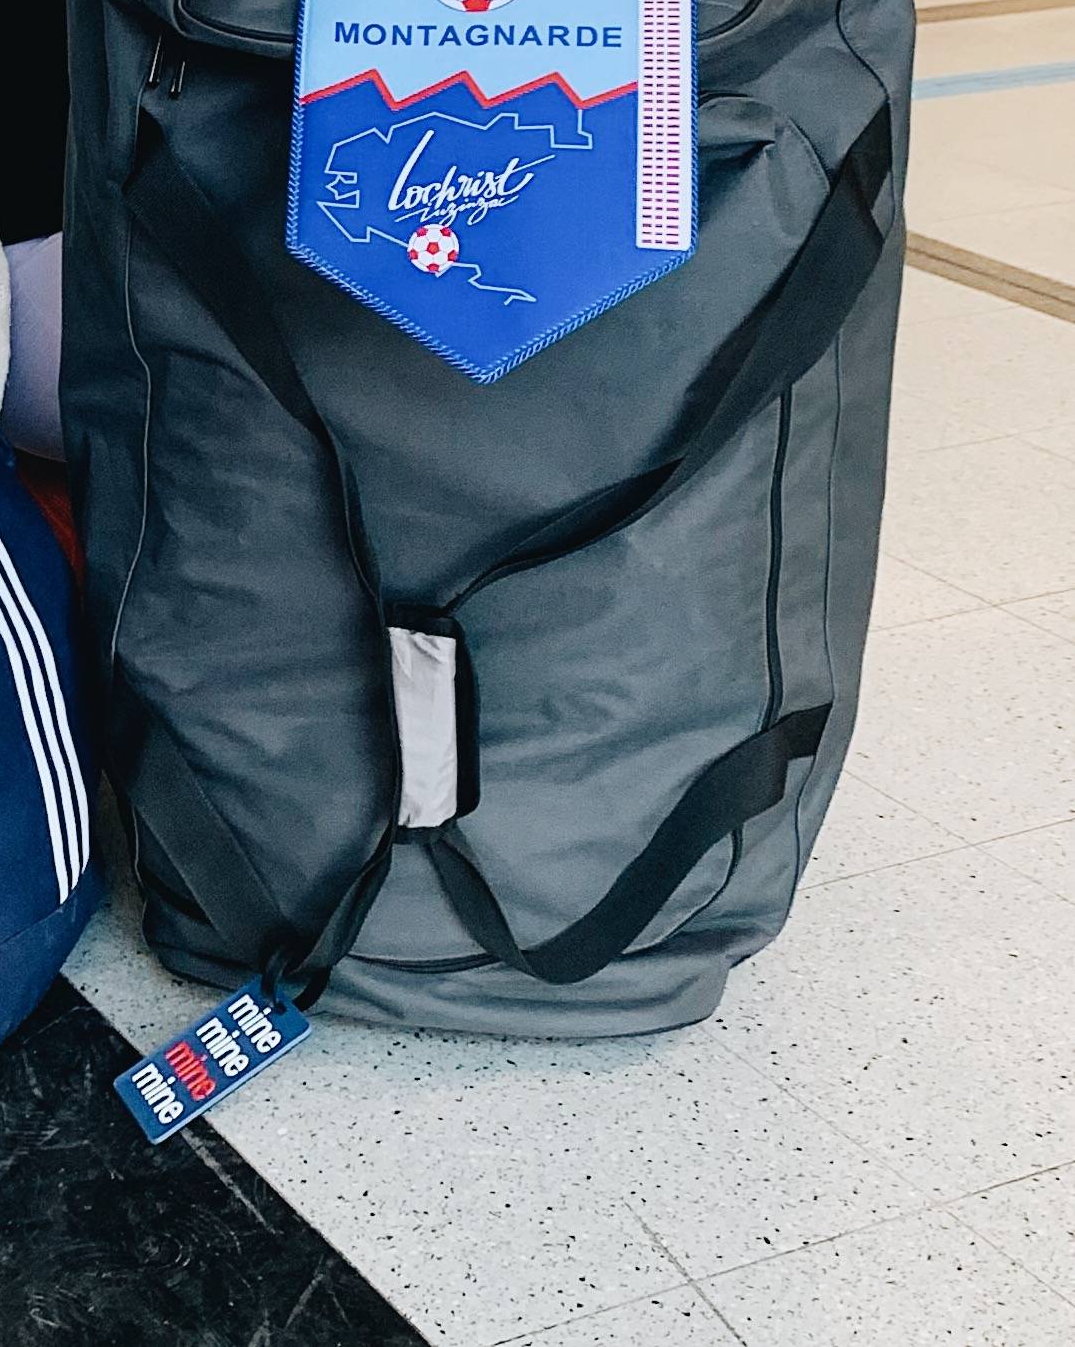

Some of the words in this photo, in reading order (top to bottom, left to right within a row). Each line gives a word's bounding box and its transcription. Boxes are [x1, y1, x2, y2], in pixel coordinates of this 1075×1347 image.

[334, 21, 623, 48] MONTAGNARDE
[195, 1017, 249, 1077] mine
[228, 994, 282, 1053] mine
[131, 1063, 184, 1124] mine
[165, 1040, 217, 1101] mine
